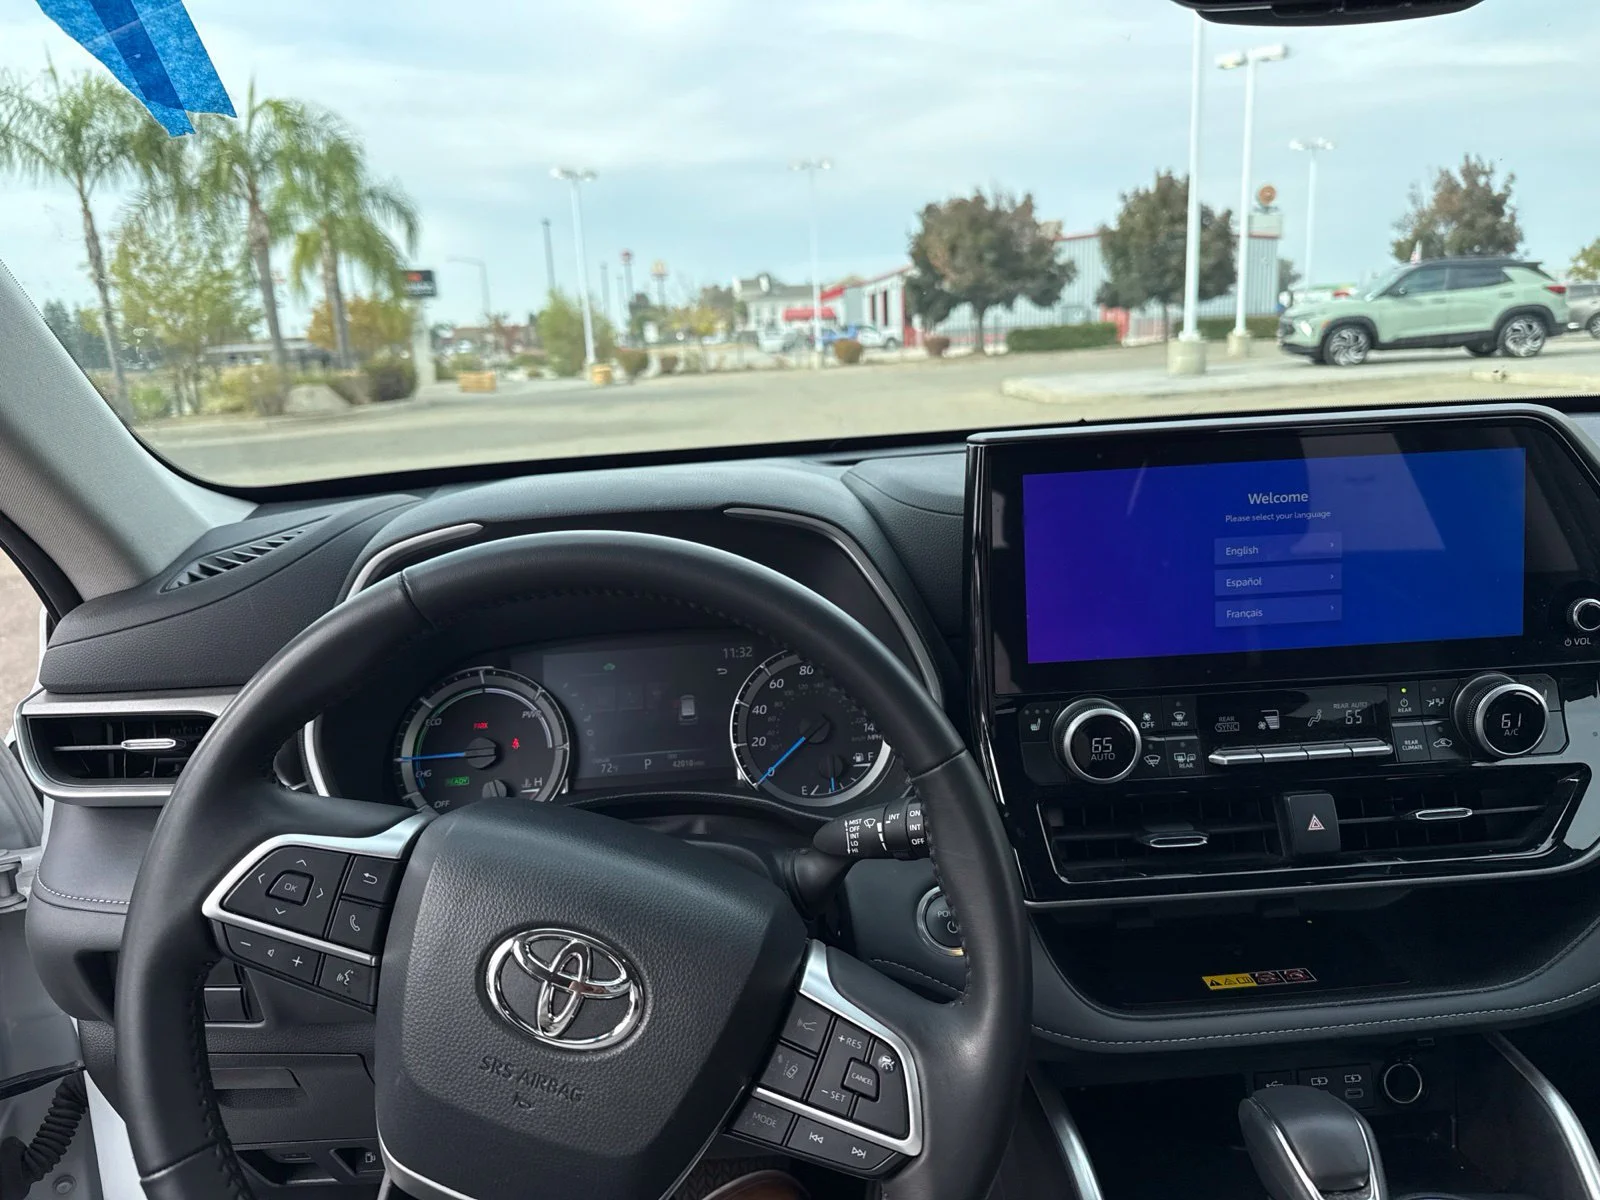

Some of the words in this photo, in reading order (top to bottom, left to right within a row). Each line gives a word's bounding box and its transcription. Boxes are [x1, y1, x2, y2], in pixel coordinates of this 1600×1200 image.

[1248, 492, 1309, 504] Welcome
[1225, 514, 1250, 523] Please
[1252, 513, 1274, 522] select
[1275, 513, 1293, 522] your
[1294, 510, 1331, 519] language
[1225, 545, 1259, 557] English
[1226, 577, 1262, 588] Español
[1226, 608, 1263, 620] Français
[1574, 637, 1592, 646] VOL
[723, 647, 753, 659] 11:32
[799, 665, 814, 675] 80
[769, 679, 784, 689] 60
[522, 709, 542, 719] PWR
[752, 705, 767, 715] 40
[1345, 709, 1362, 725] 65
[1501, 713, 1522, 729] 61
[425, 718, 442, 727] ECO
[864, 722, 876, 732] 14
[1141, 721, 1155, 729] OFF
[1218, 722, 1237, 731] SYNC
[1504, 728, 1519, 736] A/C
[751, 737, 766, 747] 20
[1091, 737, 1113, 753] 65
[868, 752, 874, 761] F
[1091, 753, 1115, 761] AUTO
[644, 759, 652, 770] P
[416, 770, 432, 778] CHG
[768, 767, 775, 777] 0
[534, 777, 542, 787] H
[801, 786, 808, 796] E
[434, 800, 450, 808] OFF
[909, 823, 921, 831] INT
[911, 838, 925, 846] OFF
[284, 882, 298, 893] OK
[480, 1055, 513, 1078] SRS
[517, 1068, 584, 1102] AIRBAG
[851, 1071, 874, 1086] CANCEL
[752, 1111, 777, 1128] MODE
